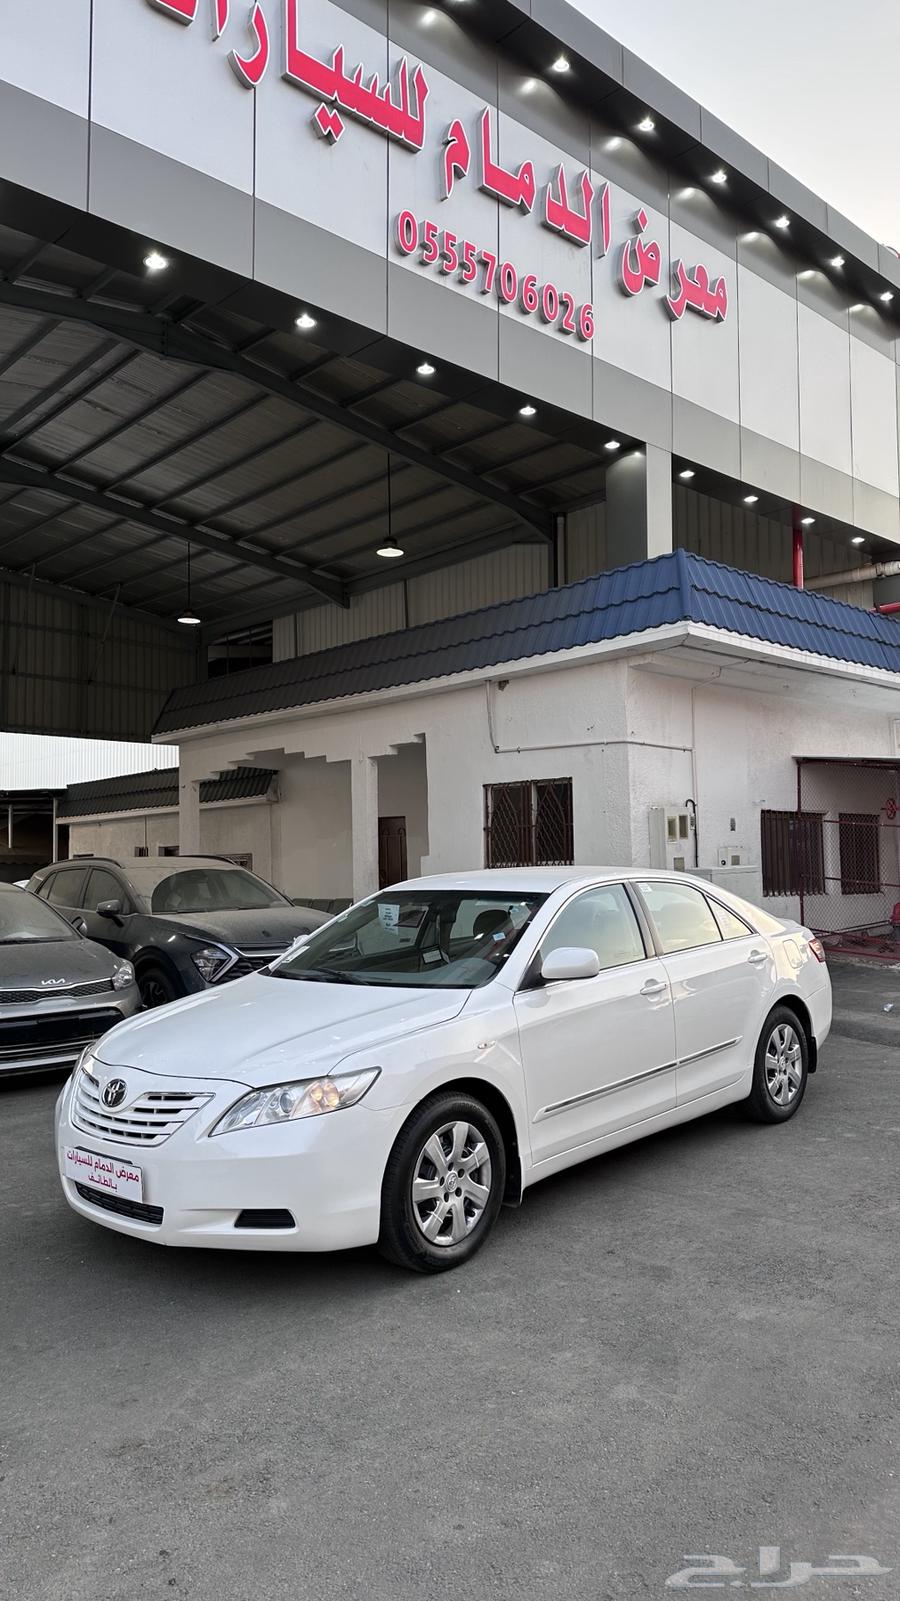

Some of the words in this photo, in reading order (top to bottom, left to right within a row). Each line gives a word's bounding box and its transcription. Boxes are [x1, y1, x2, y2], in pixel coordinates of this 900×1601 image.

[150, 0, 429, 152] للسيار
[441, 107, 612, 256] الدمام
[395, 210, 595, 341] 0555706026
[619, 208, 729, 321] معرض
[66, 1150, 93, 1167] للسيارات
[94, 1159, 114, 1174] الدمام
[115, 1166, 140, 1182] معرض
